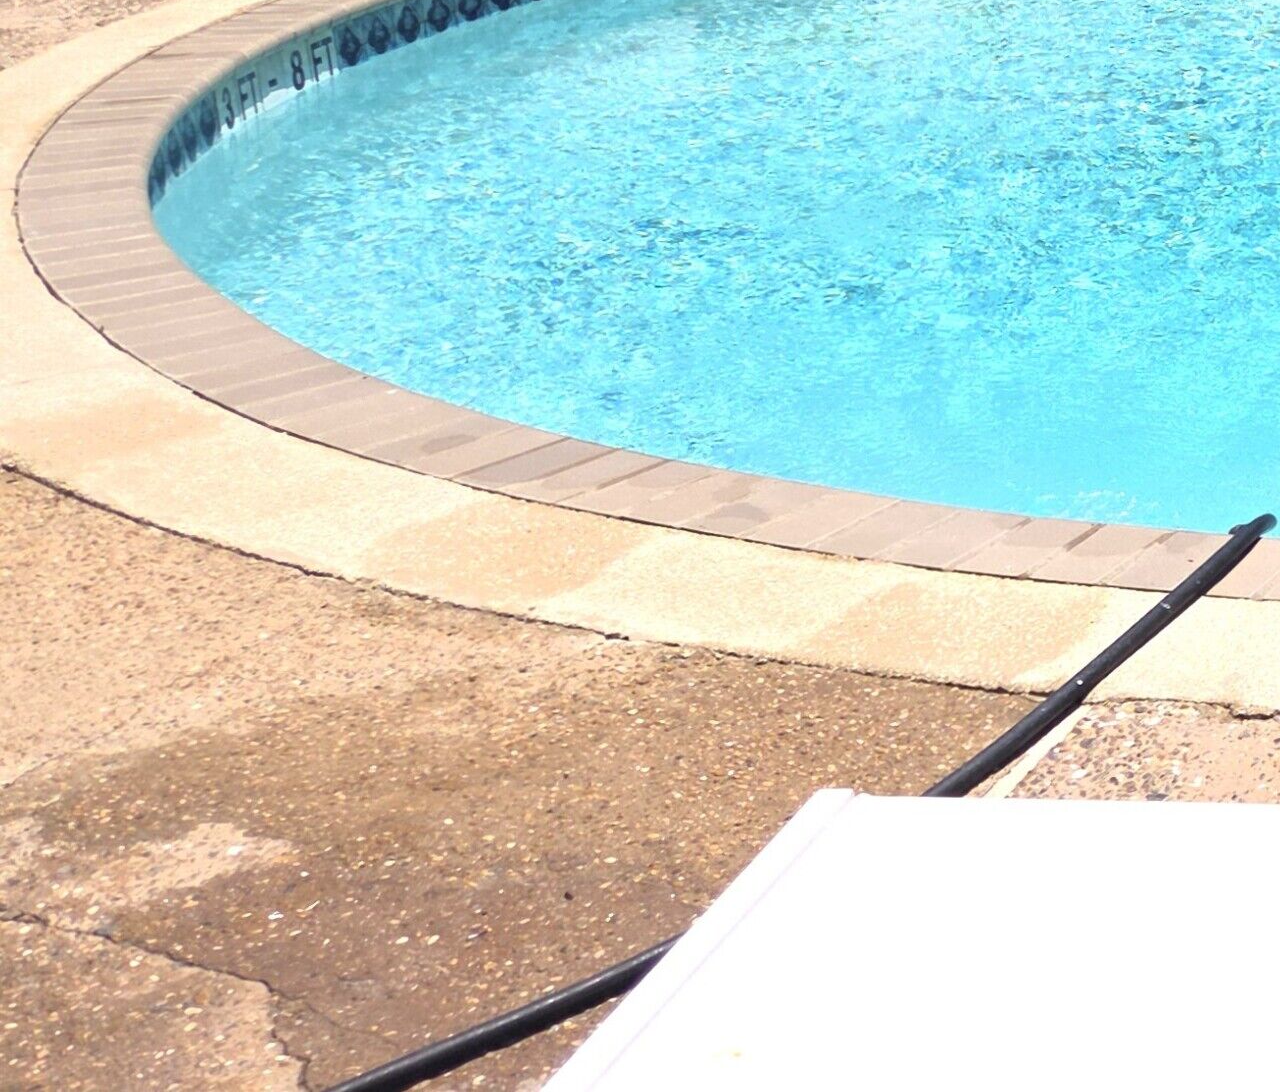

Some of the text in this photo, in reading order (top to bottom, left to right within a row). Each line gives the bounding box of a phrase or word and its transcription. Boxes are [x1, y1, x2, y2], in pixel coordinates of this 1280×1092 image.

[222, 86, 235, 130] 3
[237, 71, 258, 121] FT
[290, 50, 305, 91] 8
[310, 36, 333, 83] FT
